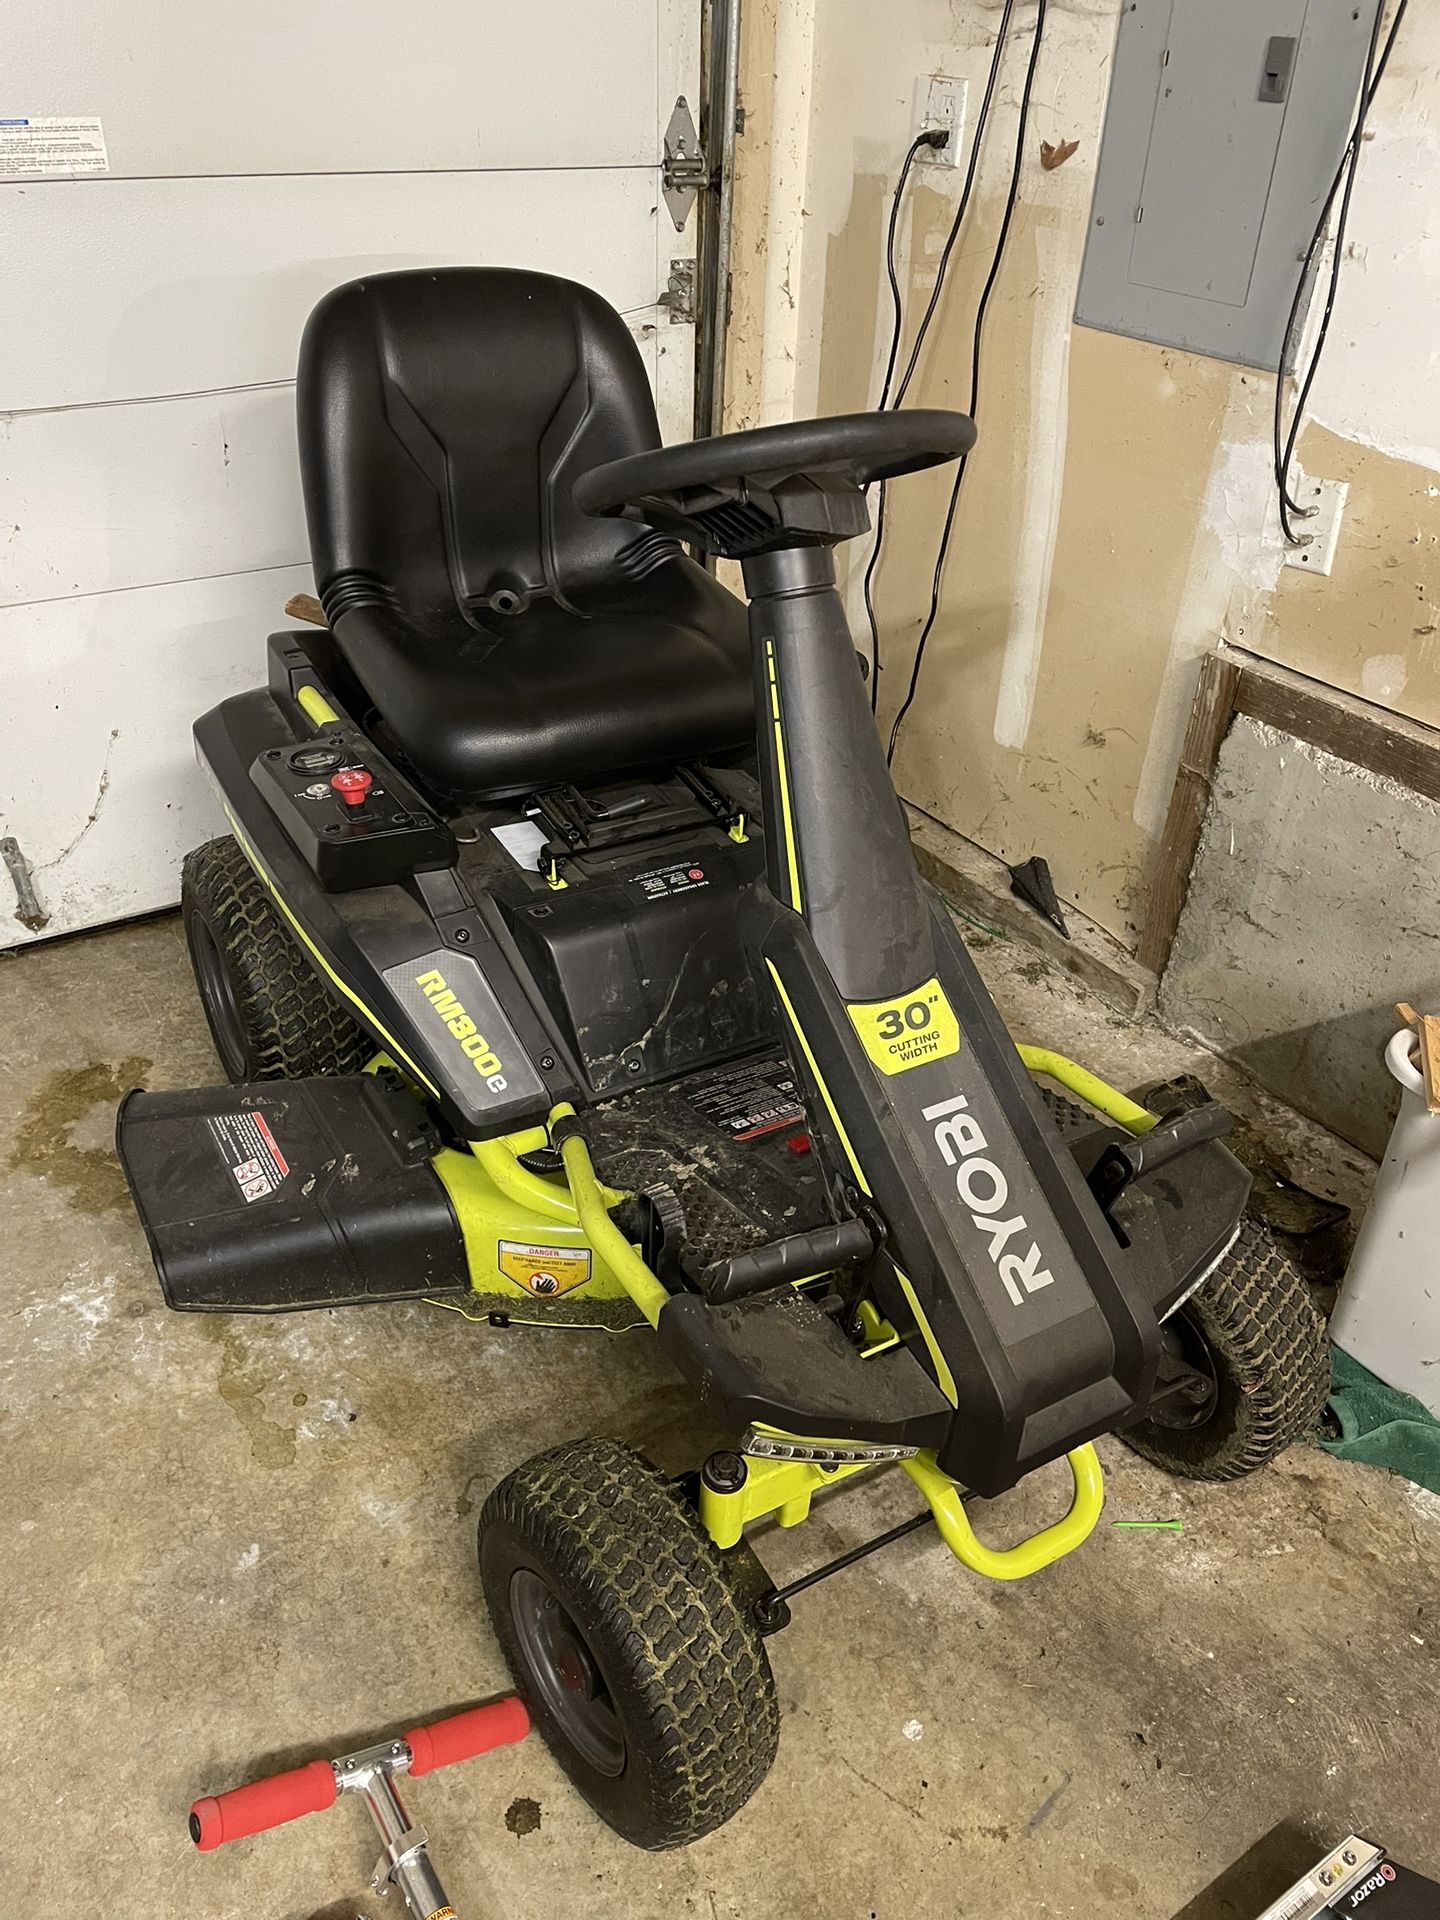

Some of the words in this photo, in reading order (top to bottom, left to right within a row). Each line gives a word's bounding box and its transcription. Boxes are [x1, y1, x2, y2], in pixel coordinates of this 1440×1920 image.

[415, 969, 508, 1093] RM300e
[876, 995, 938, 1040] 30"
[888, 1030, 940, 1054] CUTTING
[900, 1042, 938, 1061] WIDTH
[921, 1094, 1055, 1306] RYOBI
[529, 1248, 560, 1257] DANGER
[1350, 1872, 1386, 1908] Razor
